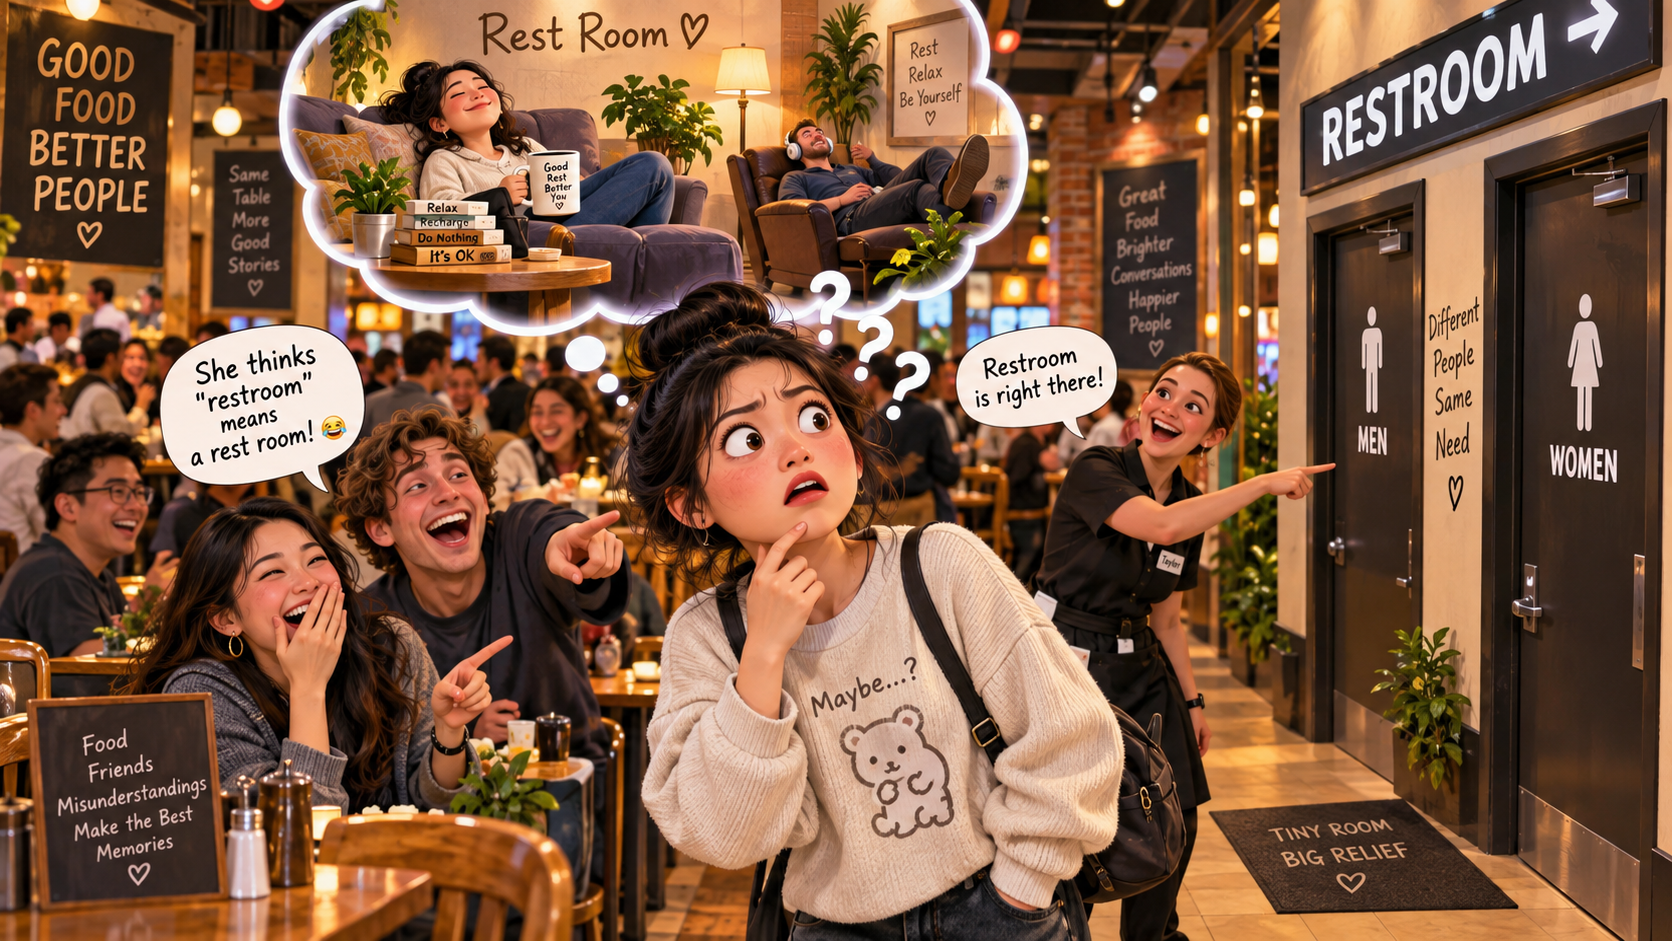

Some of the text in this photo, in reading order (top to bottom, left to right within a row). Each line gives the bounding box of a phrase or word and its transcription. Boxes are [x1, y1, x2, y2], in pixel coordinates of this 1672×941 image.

[477, 11, 669, 56] Rest Room
[37, 37, 135, 83] GOOD
[910, 38, 939, 60] Rest
[908, 63, 943, 84] Relax
[899, 82, 963, 109] Be Yourself
[1322, 13, 1547, 167] RESTROOM
[55, 86, 136, 126] FOOD
[29, 129, 146, 171] BETTER
[228, 164, 269, 183] Same
[543, 160, 569, 173] Good
[546, 173, 567, 183] Rest
[34, 175, 150, 213] PEOPLE
[232, 187, 271, 205] Table
[427, 202, 458, 213] Relax
[1118, 180, 1167, 208] Great
[232, 211, 270, 228] More
[1125, 207, 1159, 232] Food
[231, 232, 270, 252] Good
[418, 232, 478, 246] Do Nothing
[1116, 235, 1174, 263] Brighter
[228, 256, 280, 274] Stories
[429, 249, 451, 264] It's
[455, 248, 475, 262] OK
[1111, 261, 1193, 285] Conversations
[1128, 289, 1180, 313] Happier
[1129, 312, 1172, 337] People
[1428, 296, 1480, 342] Different
[1433, 339, 1475, 380] People
[1435, 386, 1473, 416] Same
[1357, 425, 1387, 456] MEN
[1435, 421, 1470, 461] Need
[1549, 444, 1618, 483] WOMEN
[810, 655, 918, 718] Maybe...?
[82, 727, 128, 756] Food
[88, 753, 154, 783] Friends
[57, 777, 207, 817] Misunderstandings
[74, 805, 193, 842] Make the Best
[1267, 818, 1394, 843] TINY ROOM
[96, 836, 174, 863] Memories
[1280, 841, 1408, 868] BIG RELIEF
